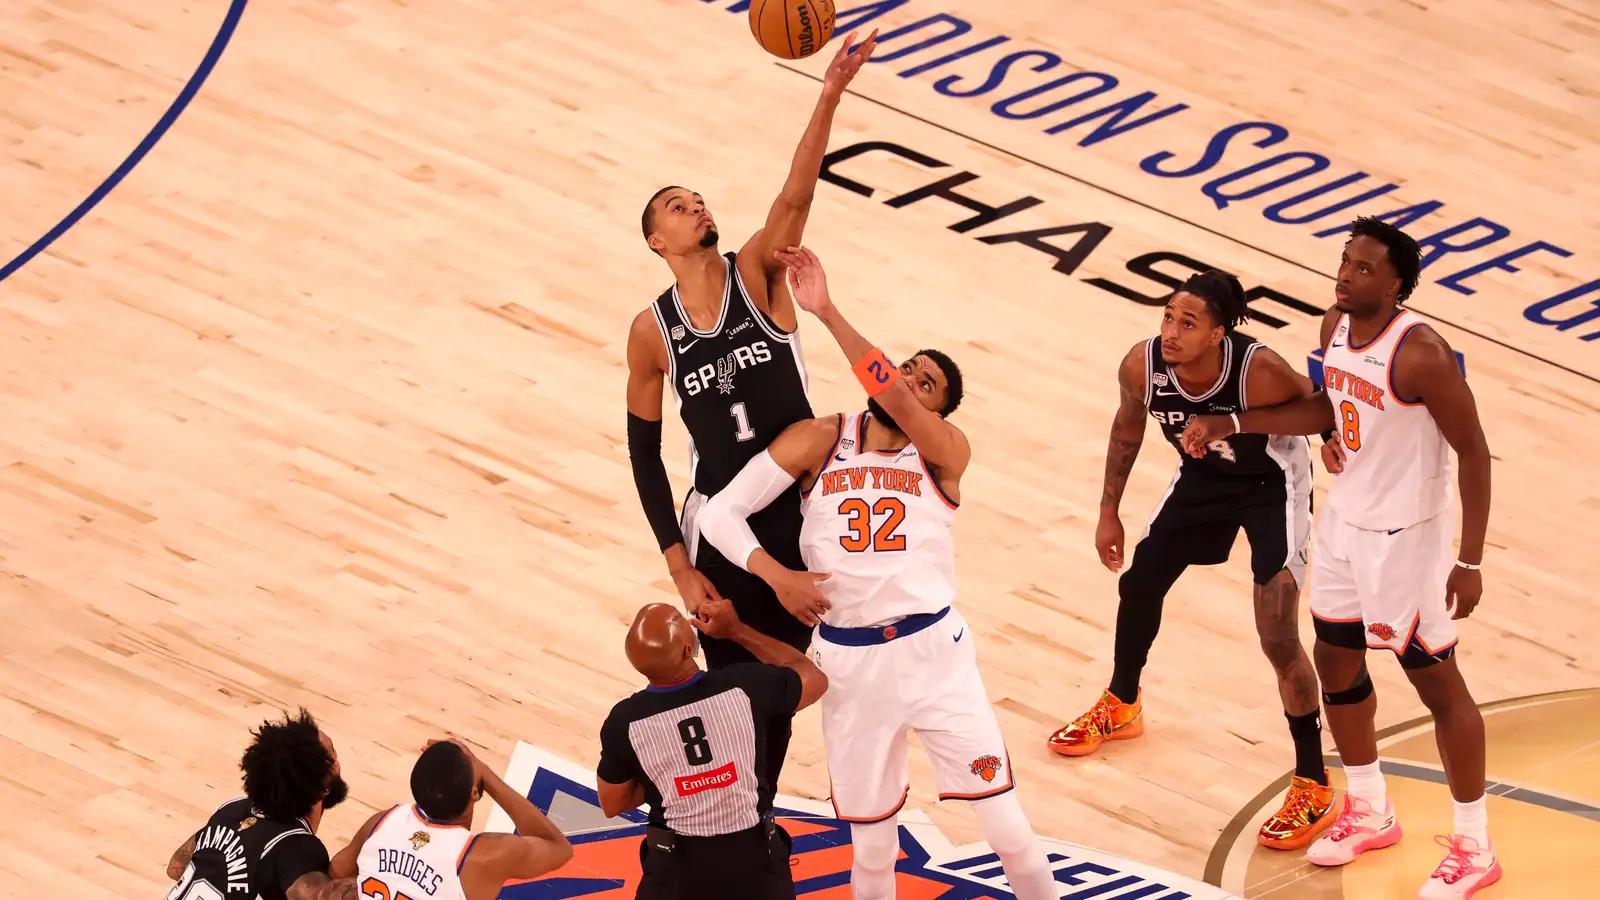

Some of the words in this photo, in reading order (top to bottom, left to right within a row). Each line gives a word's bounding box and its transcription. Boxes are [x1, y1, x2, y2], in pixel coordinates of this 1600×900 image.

[797, 4, 814, 57] Wilson
[698, 0, 1191, 147] ADISON
[1347, 371, 1385, 412] YORK
[729, 401, 756, 442] 1
[1339, 400, 1362, 452] 8
[822, 466, 868, 497] NEW
[869, 466, 923, 497] YORK
[838, 497, 907, 553] 32
[677, 716, 714, 767] 8
[681, 770, 732, 792] Emirates
[192, 825, 250, 894] AMPAGNIE
[378, 848, 443, 896] BRIDGES
